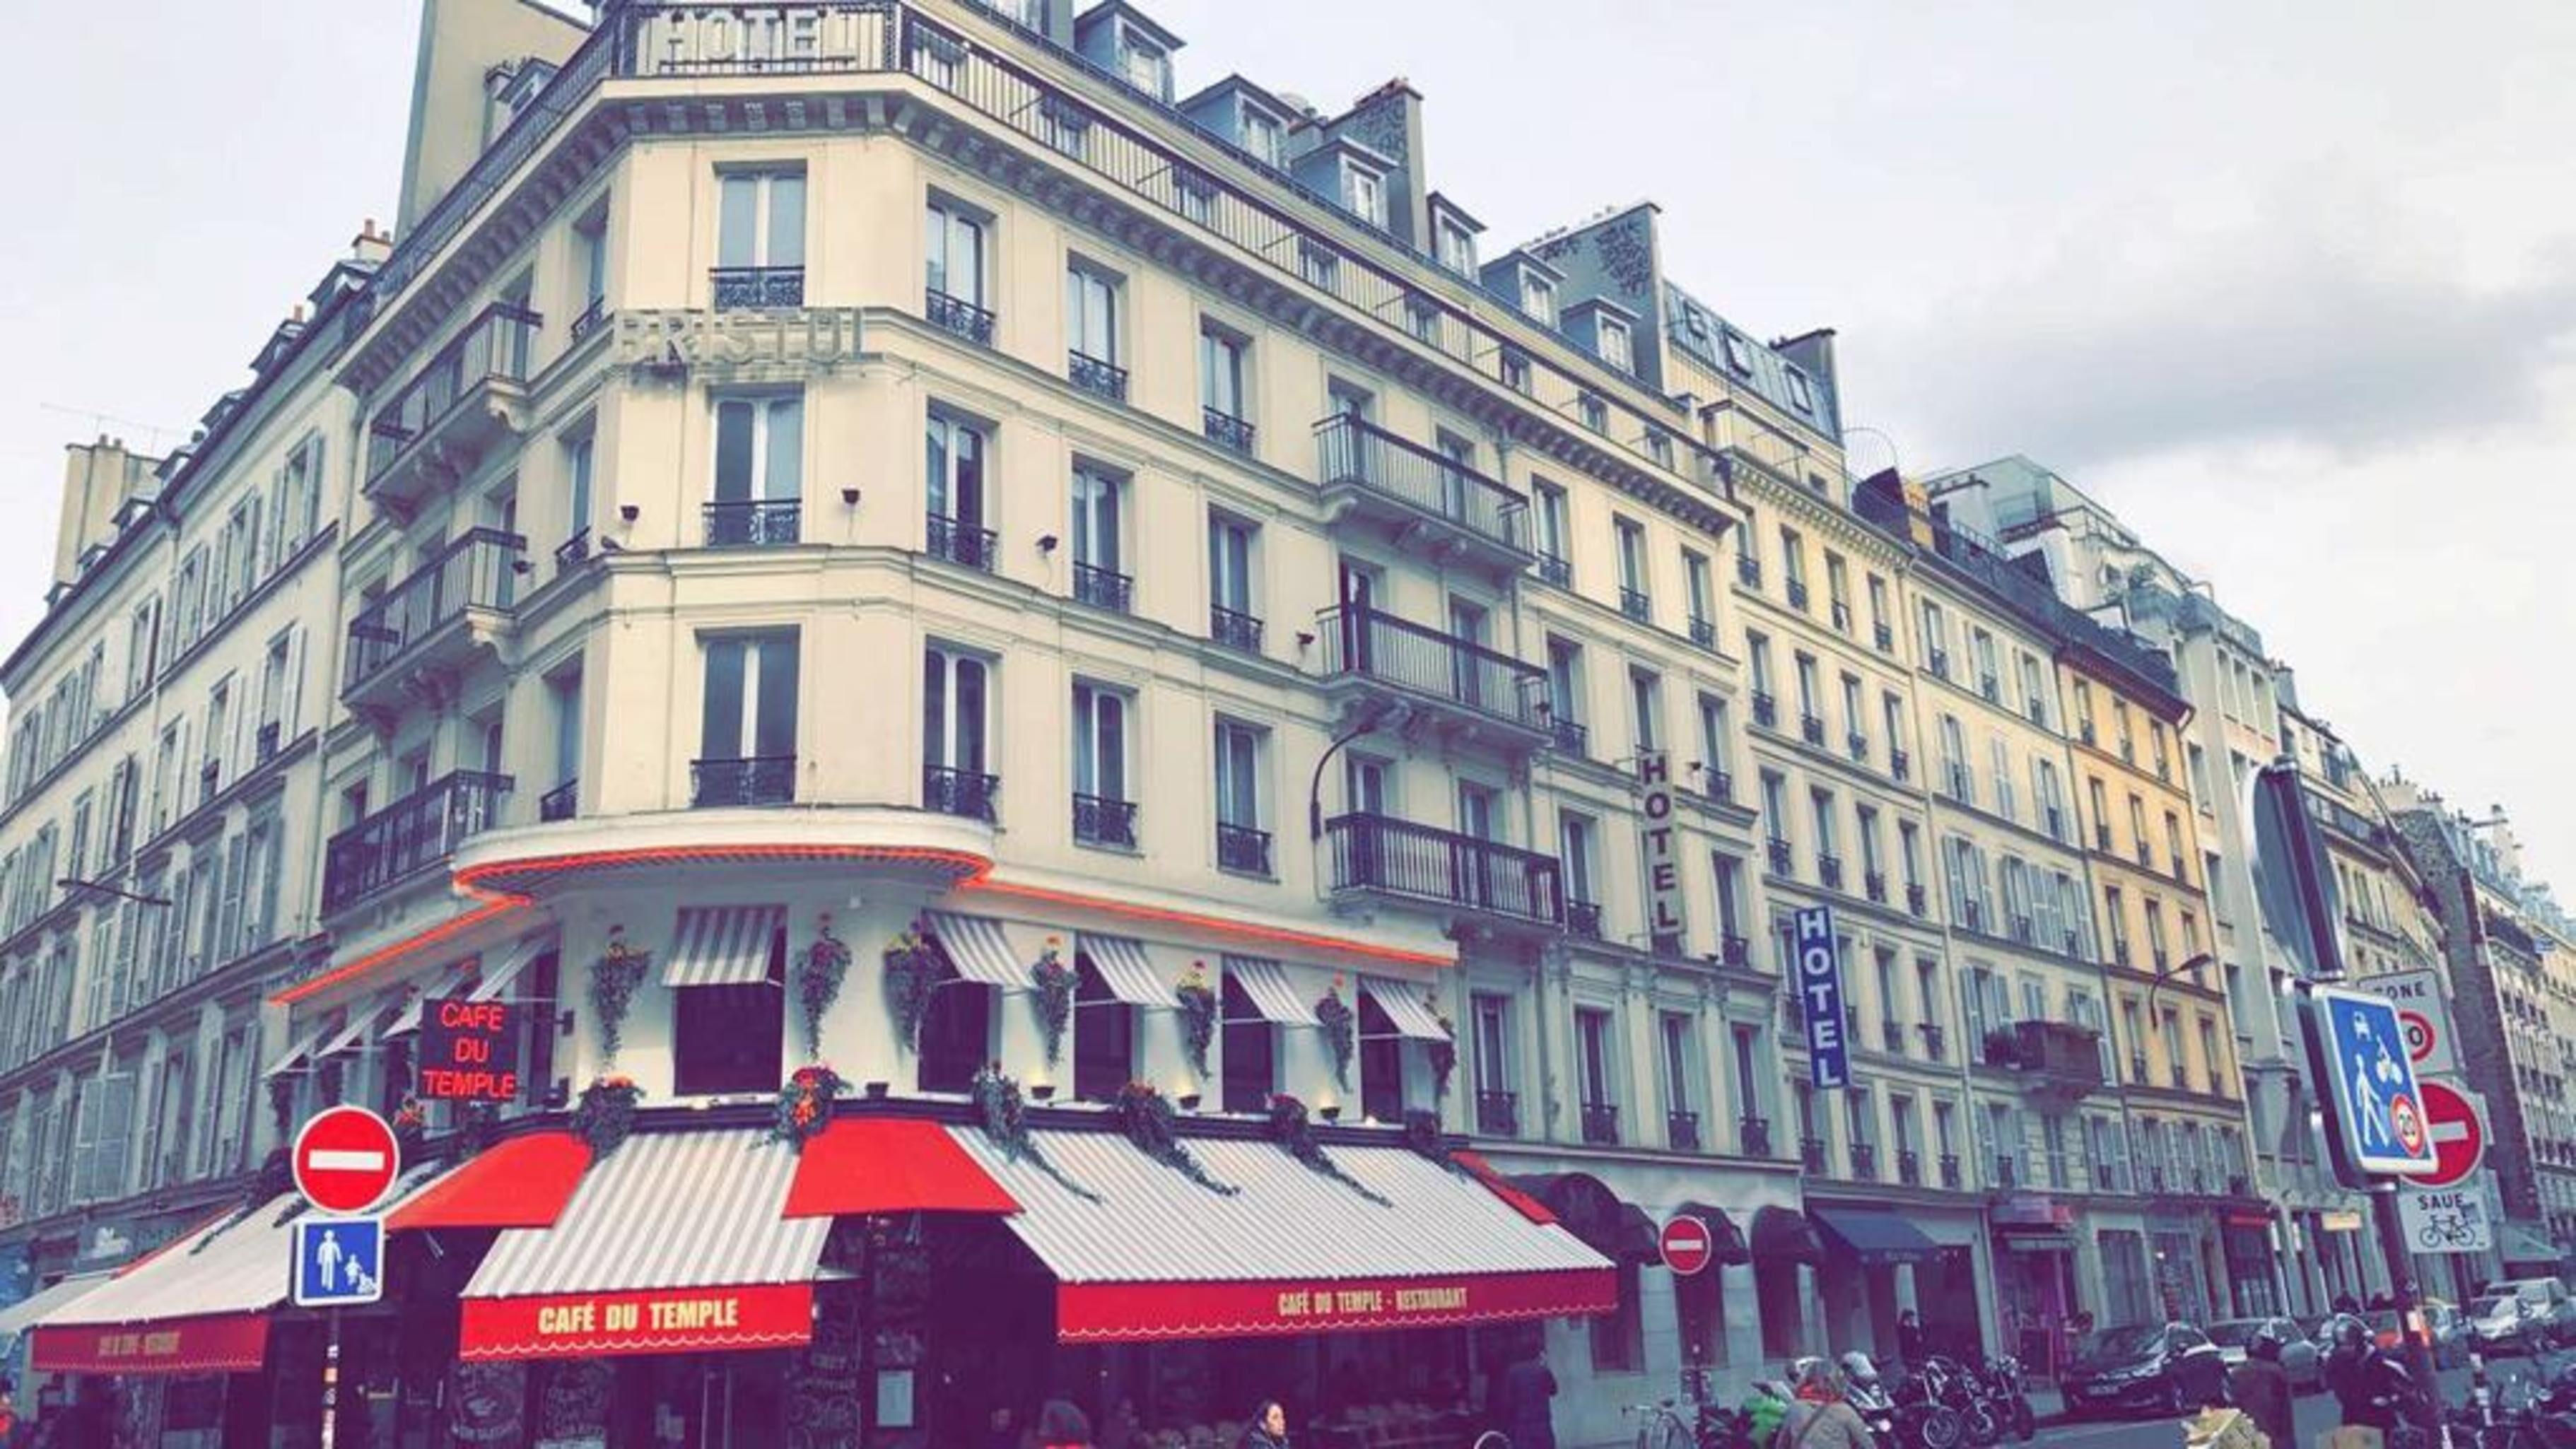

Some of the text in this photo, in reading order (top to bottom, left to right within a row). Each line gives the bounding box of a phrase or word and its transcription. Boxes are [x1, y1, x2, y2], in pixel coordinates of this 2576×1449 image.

[655, 8, 856, 61] HOTEL
[1643, 756, 1678, 930] HOTEL
[1801, 910, 1842, 1087] HOTEL
[441, 1002, 504, 1031] CAFE
[455, 1038, 489, 1062] DU
[423, 1070, 516, 1097] TEMPLE
[539, 1298, 738, 1334] CAFÉ DU TEMPLE
[1337, 1290, 1383, 1313] TEMPLE
